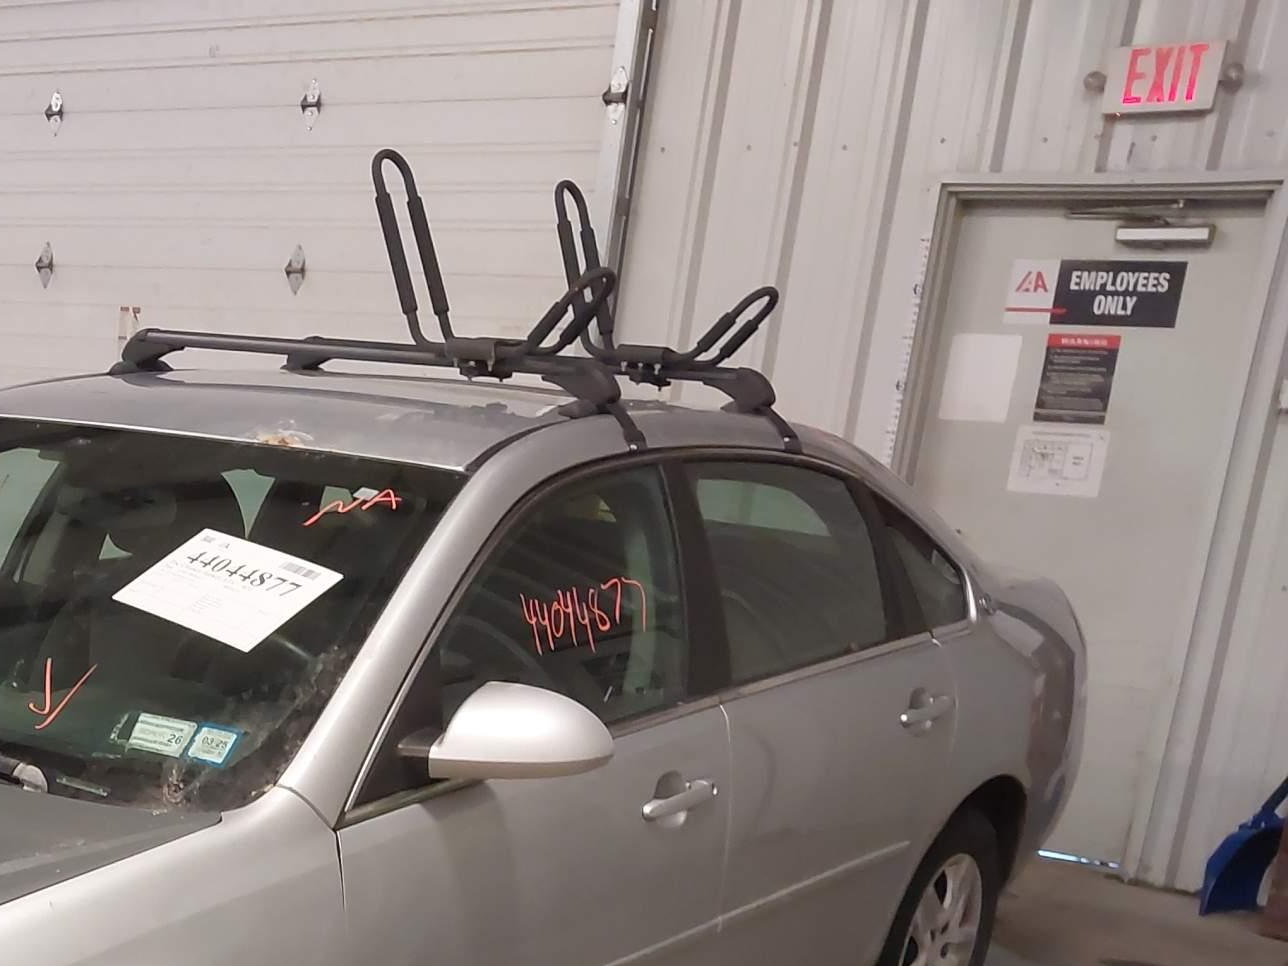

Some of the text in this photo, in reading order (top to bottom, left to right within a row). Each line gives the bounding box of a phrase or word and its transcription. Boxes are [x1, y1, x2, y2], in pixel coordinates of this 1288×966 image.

[1122, 44, 1210, 104] EXIT
[1069, 271, 1171, 293] EMPLOYEES
[1092, 295, 1138, 316] ONLY
[186, 551, 304, 597] 44044877
[519, 576, 647, 657] 44044877
[167, 733, 184, 745] 26
